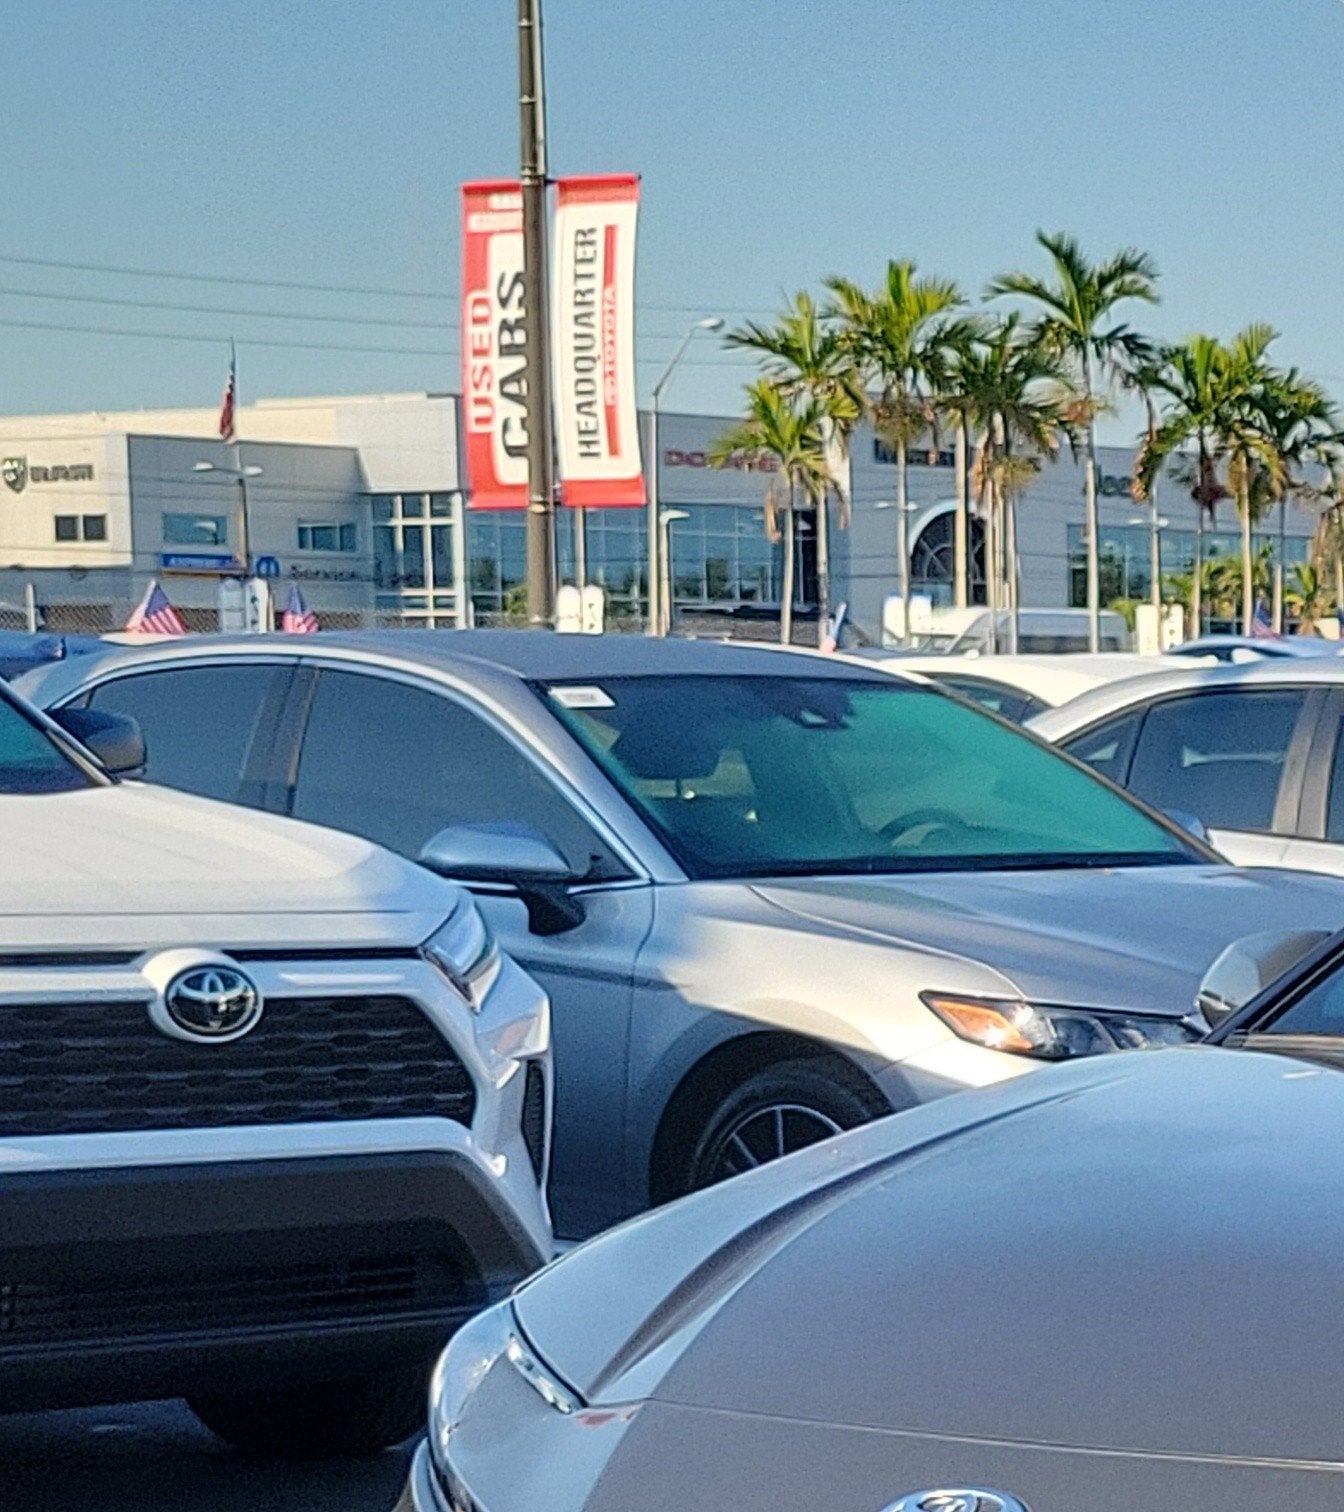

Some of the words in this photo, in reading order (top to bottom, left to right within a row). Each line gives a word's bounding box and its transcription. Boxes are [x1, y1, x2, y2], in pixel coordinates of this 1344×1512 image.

[469, 291, 496, 429] USED
[498, 270, 529, 458] CARS
[572, 226, 602, 459] HEADQUARTER
